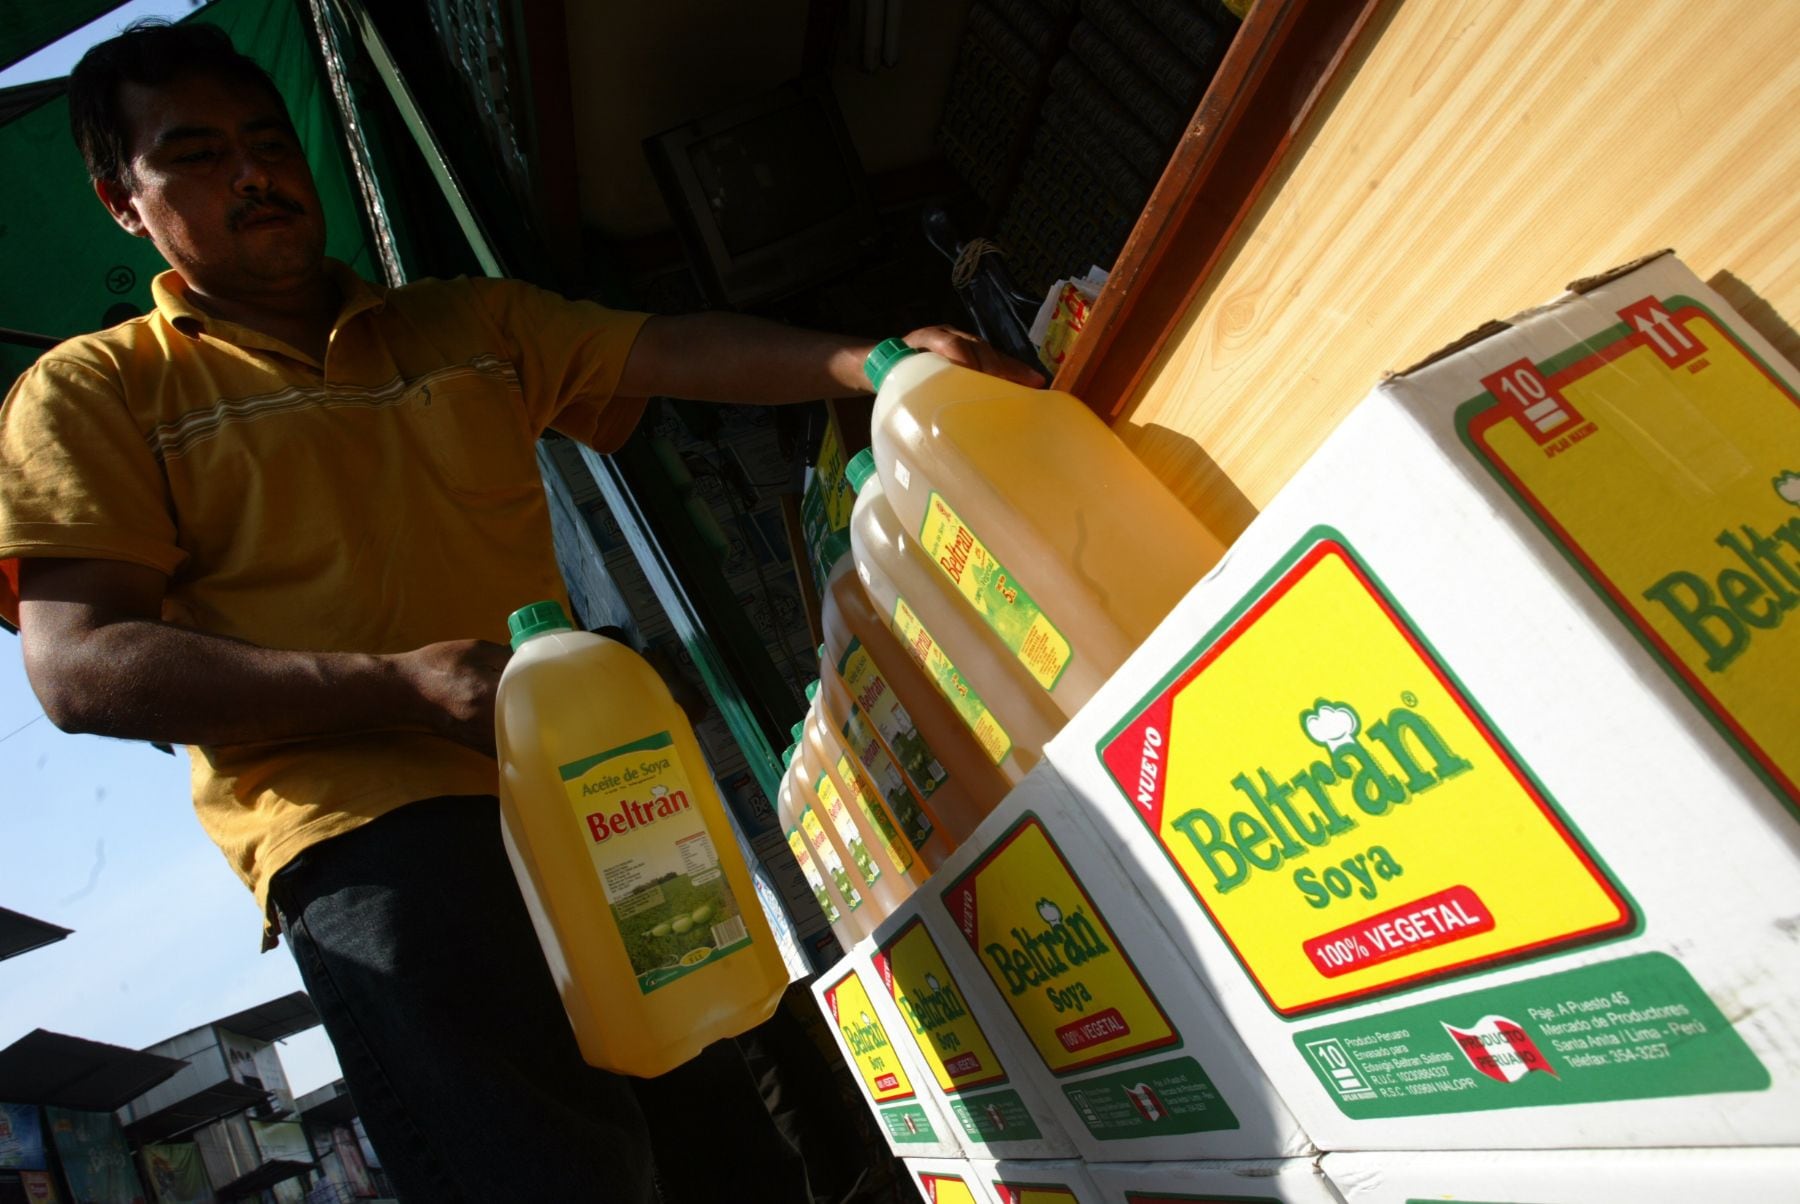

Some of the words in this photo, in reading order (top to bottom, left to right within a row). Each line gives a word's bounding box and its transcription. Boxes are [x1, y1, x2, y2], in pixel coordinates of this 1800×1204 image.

[1501, 368, 1546, 407] 10
[940, 525, 974, 585] Beltran
[581, 775, 621, 798] Aceite
[623, 767, 640, 782] de
[639, 758, 671, 776] Soya
[1136, 726, 1163, 811] NUEVO
[586, 790, 690, 844] Beltran
[1171, 704, 1474, 895] Beltran
[1293, 845, 1404, 910] Soya
[1316, 936, 1370, 969] 100%
[1363, 899, 1480, 952] VEGETAL
[984, 911, 1110, 997] Beltran
[1046, 981, 1093, 1013] Soya
[1567, 997, 1611, 1015] Puesto
[1610, 991, 1630, 1007] 45
[1080, 1015, 1125, 1040] VEGETAL
[1539, 1019, 1592, 1037] Mercado
[1591, 1015, 1609, 1031] de
[1608, 1002, 1690, 1026] Productores
[1551, 1036, 1589, 1053] Santa
[1627, 1025, 1661, 1043] Lima
[1318, 1045, 1347, 1070] 10
[1458, 1029, 1526, 1051] PRODUCTO
[1476, 1051, 1537, 1070] PERUANO
